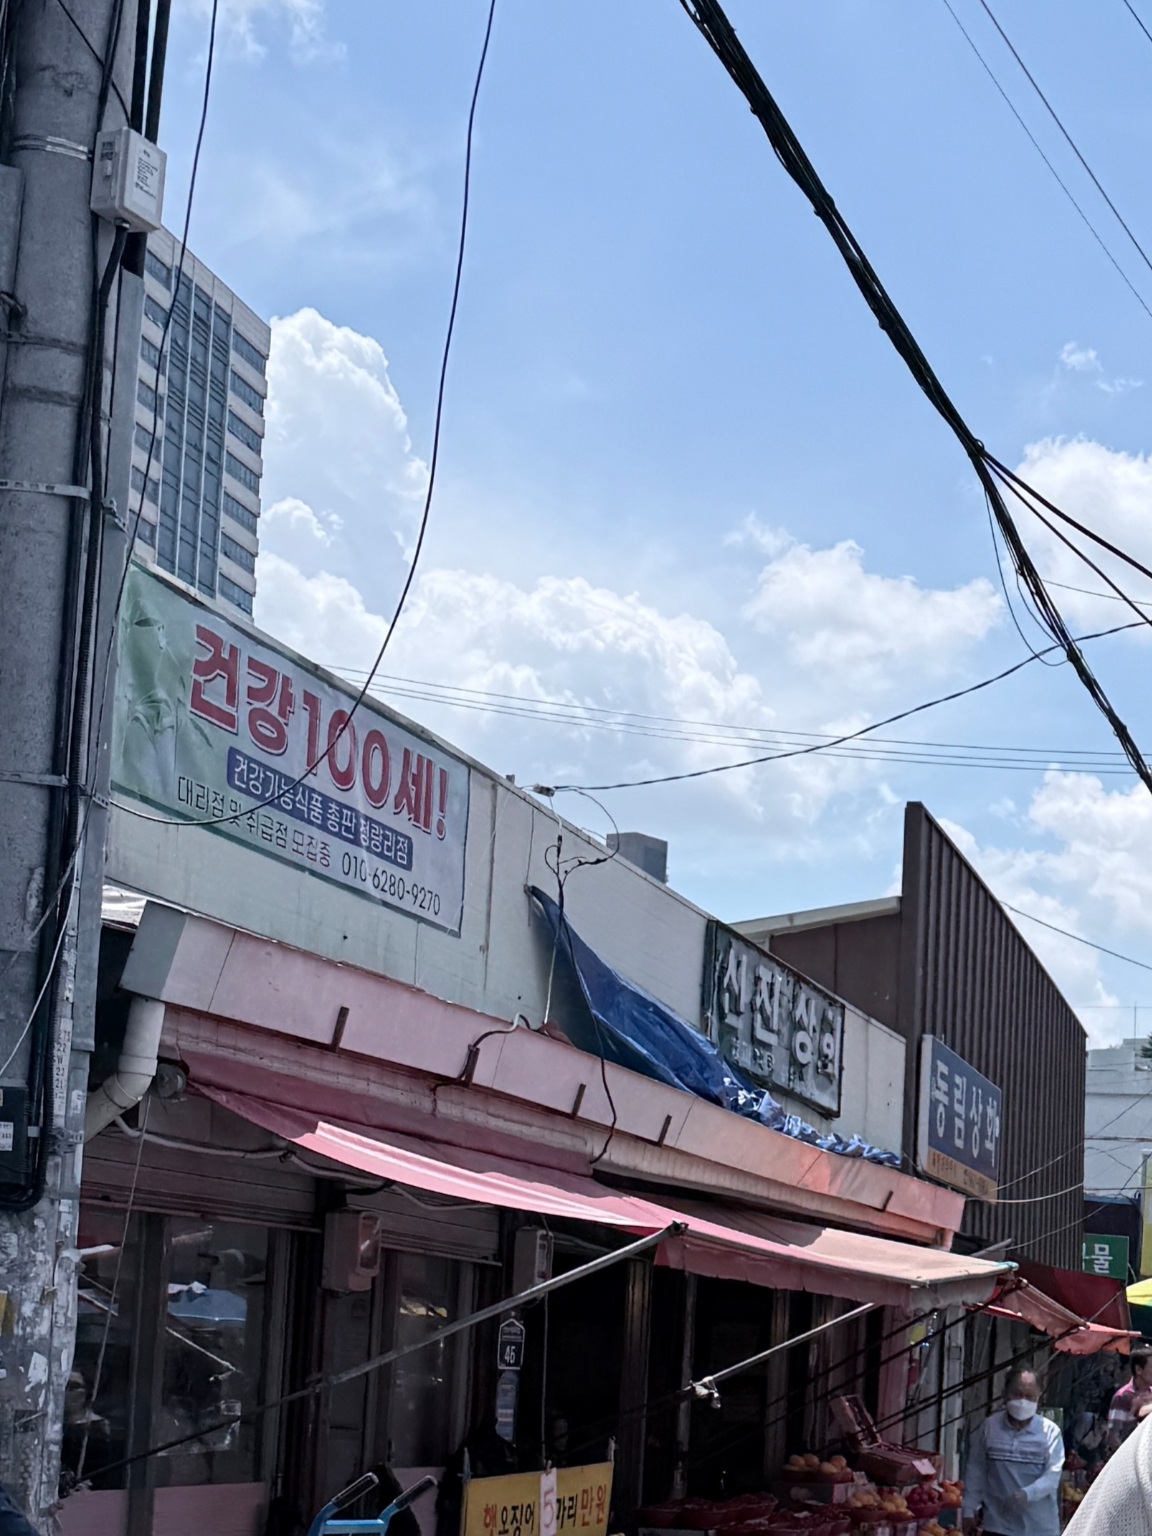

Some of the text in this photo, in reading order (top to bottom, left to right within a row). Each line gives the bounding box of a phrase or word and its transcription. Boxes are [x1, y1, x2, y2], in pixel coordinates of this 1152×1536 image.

[234, 754, 323, 825] 건강기능식품
[326, 800, 358, 839] 총판
[177, 775, 226, 818] 대리점
[246, 810, 288, 849] 취급점
[291, 828, 332, 869] 모집중
[341, 851, 442, 917] 010-6280-9270
[580, 1483, 607, 1528] 만원
